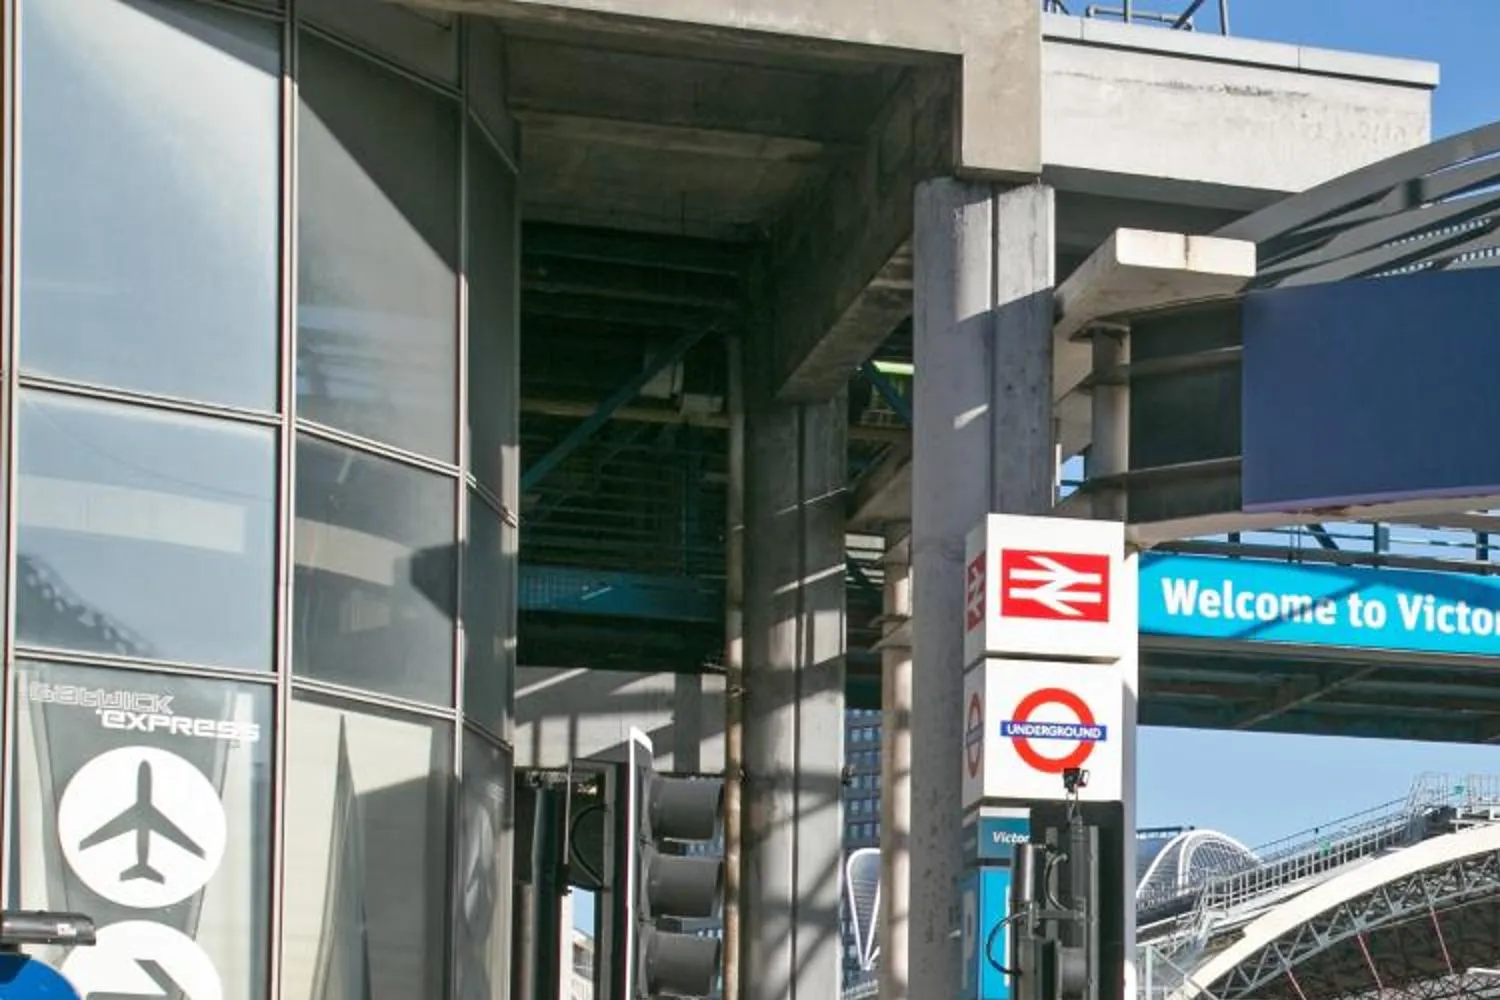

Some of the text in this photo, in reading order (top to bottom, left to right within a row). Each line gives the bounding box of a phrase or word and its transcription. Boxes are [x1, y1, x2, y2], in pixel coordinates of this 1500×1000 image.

[1160, 576, 1337, 626] Welcome
[1348, 591, 1387, 630] to
[1007, 722, 1102, 740] UNDERGROUND
[992, 831, 1031, 844] Victor
